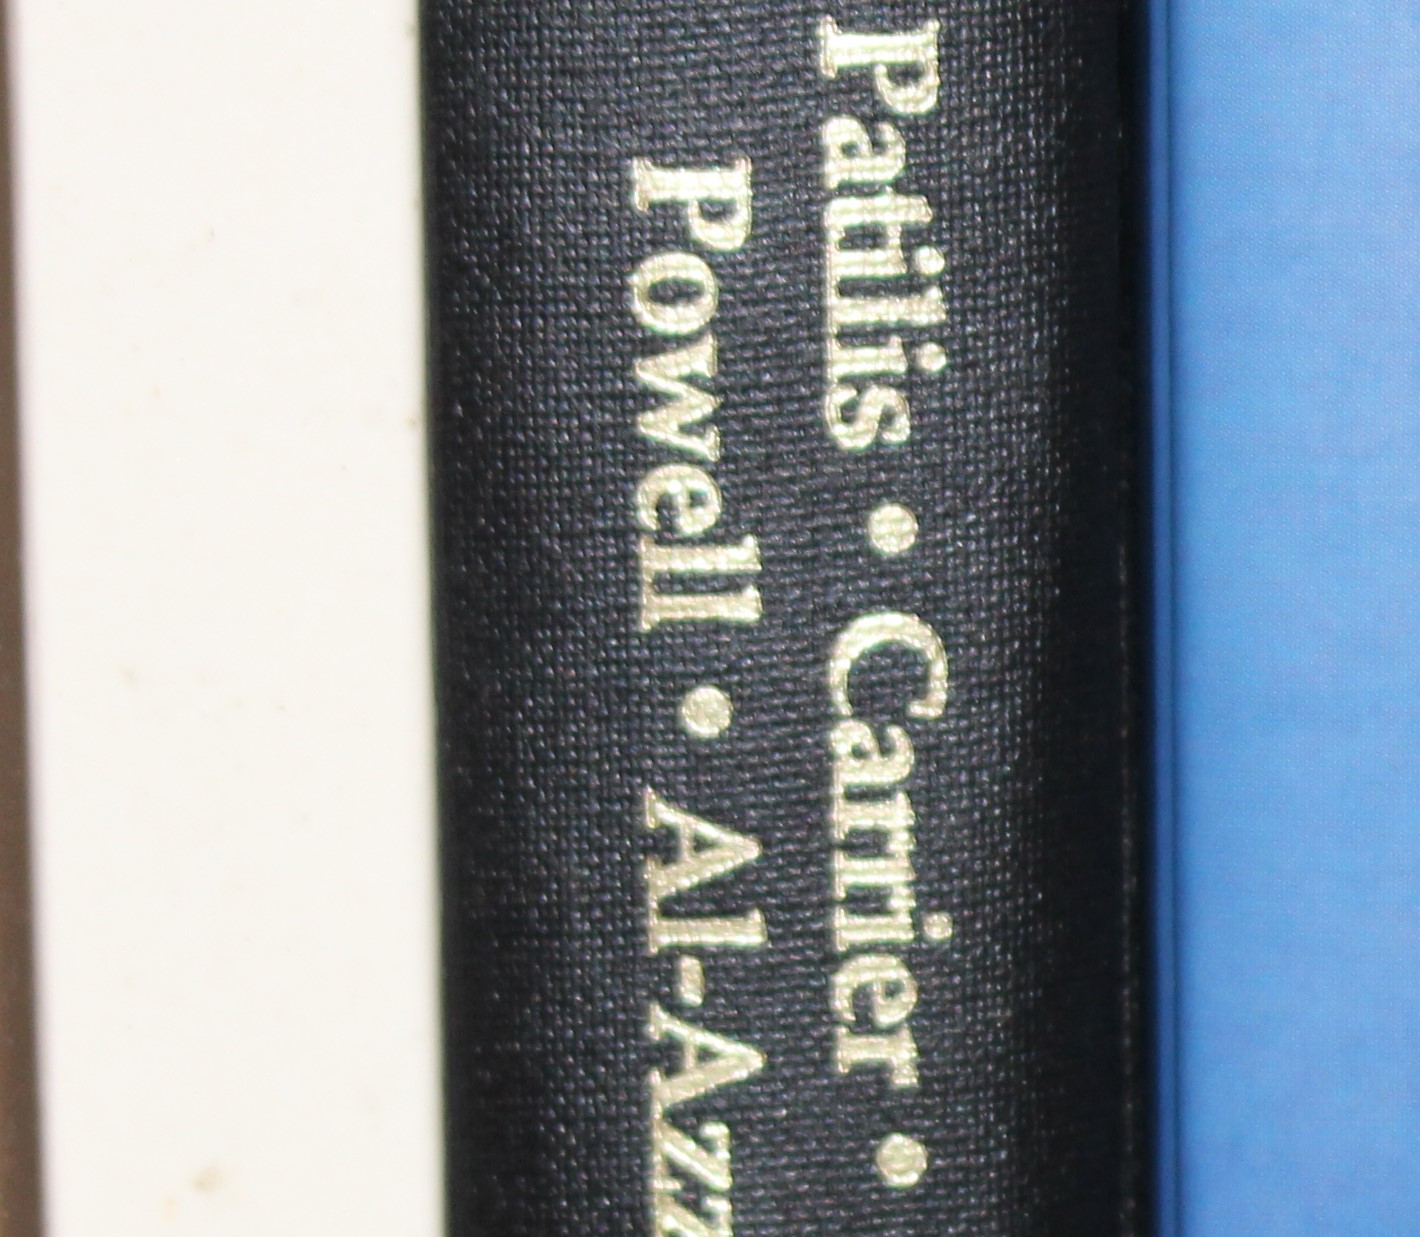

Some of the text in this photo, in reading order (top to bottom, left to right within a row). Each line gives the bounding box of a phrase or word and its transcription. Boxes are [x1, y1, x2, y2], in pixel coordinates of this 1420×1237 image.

[630, 154, 762, 632] Powell
[816, 16, 947, 452] Patilis
[826, 610, 952, 1089] Carrier
